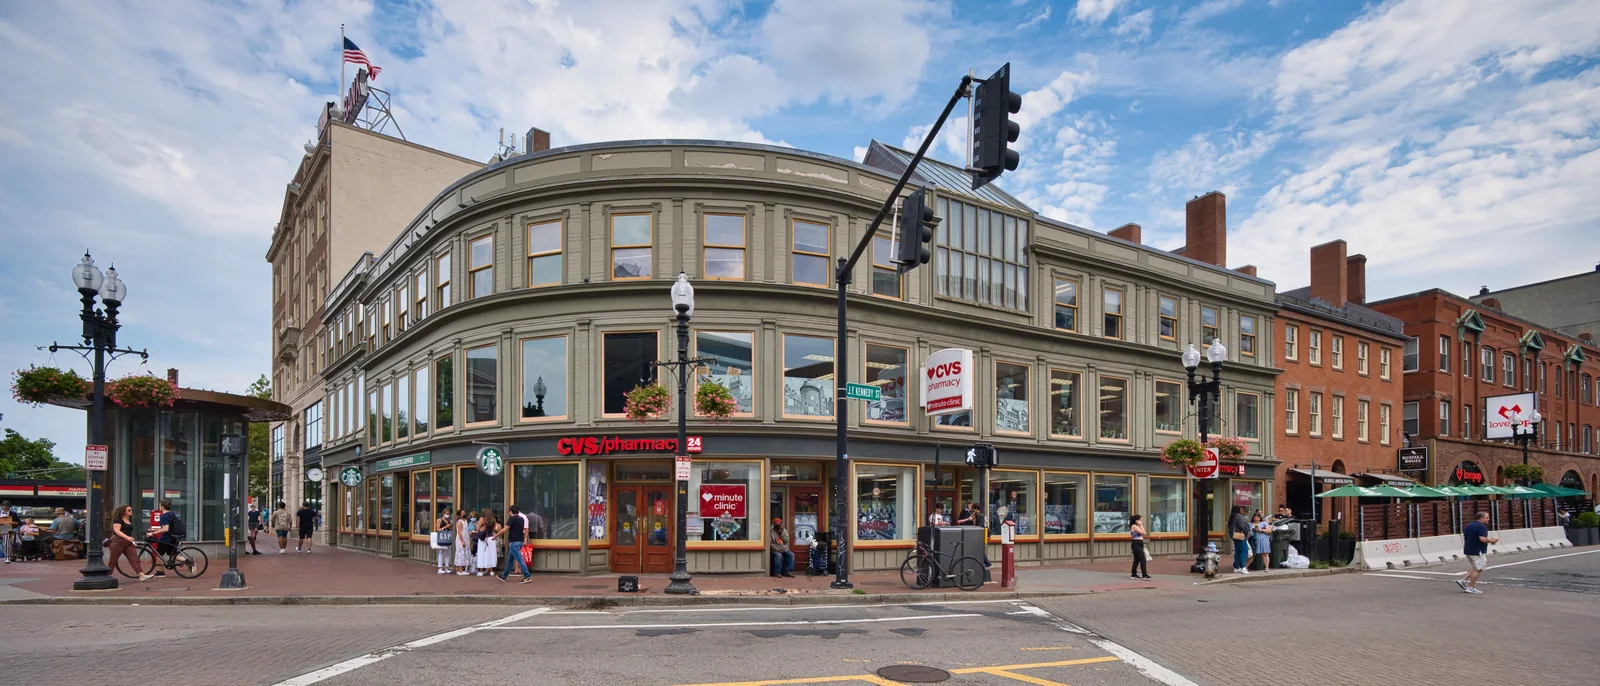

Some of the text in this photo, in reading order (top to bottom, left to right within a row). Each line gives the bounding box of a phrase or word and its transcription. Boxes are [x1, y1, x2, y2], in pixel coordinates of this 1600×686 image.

[936, 361, 962, 378] CVS
[928, 379, 961, 393] pharmacy
[855, 387, 874, 398] KENNEDY
[874, 389, 880, 399] ST
[931, 398, 961, 408] minute clinic
[1489, 420, 1530, 428] loveop
[688, 437, 701, 447] 24
[1464, 469, 1482, 483] lovepop
[714, 493, 743, 502] minute
[714, 502, 736, 510] clinic
